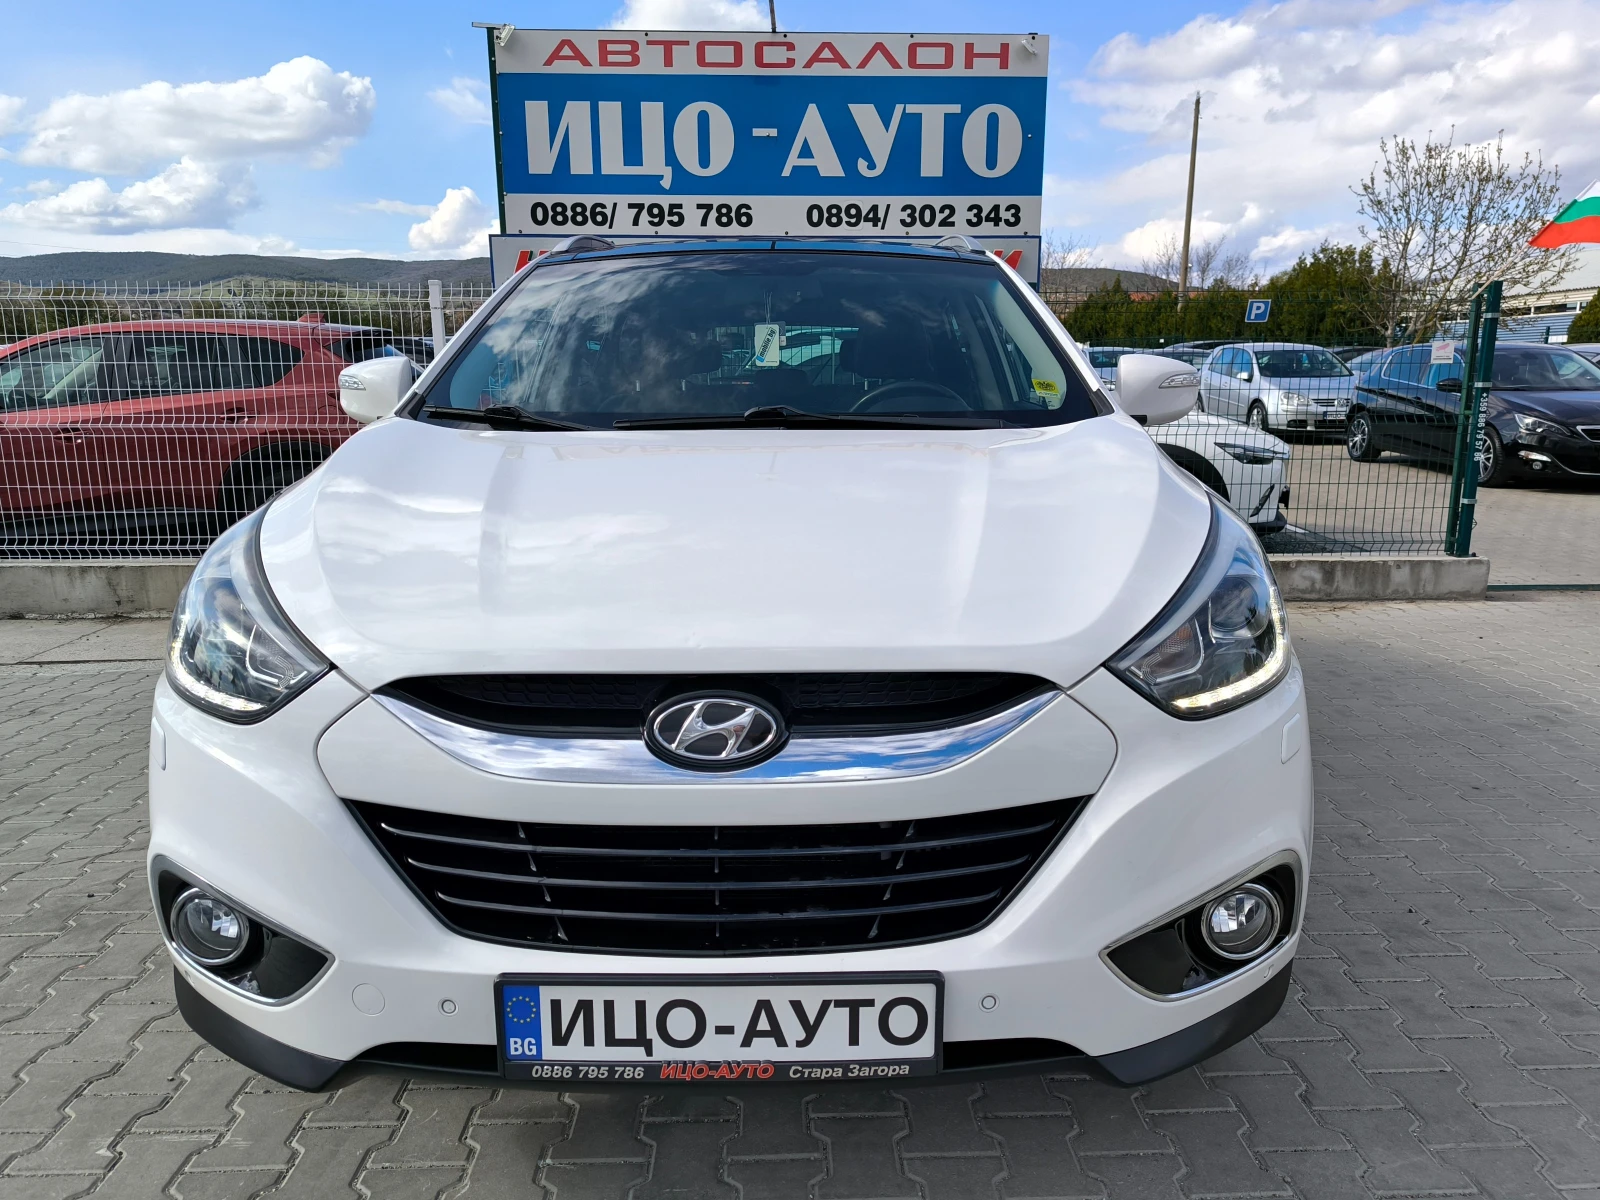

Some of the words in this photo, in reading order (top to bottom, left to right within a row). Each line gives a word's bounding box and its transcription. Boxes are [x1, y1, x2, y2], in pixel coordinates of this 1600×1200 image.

[542, 39, 1010, 70] АВТОСАЛОН
[530, 202, 618, 230] 0886/
[627, 203, 685, 228] 795
[695, 203, 753, 228] 786
[805, 204, 891, 230] 0894/
[899, 205, 956, 228] 302
[965, 205, 1022, 228] 343
[1250, 302, 1265, 319] P
[1479, 392, 1488, 411] +359
[1478, 413, 1486, 427] 886
[1476, 430, 1484, 439] 79
[549, 996, 929, 1057] ИЦО-АУТО
[509, 1037, 537, 1055] BG
[531, 1065, 573, 1078] 0886
[578, 1066, 609, 1079] 795
[613, 1066, 645, 1079] 786
[660, 1062, 775, 1081] ИЦО-АУТО
[789, 1065, 843, 1080] Стара
[847, 1063, 910, 1077] Загора
